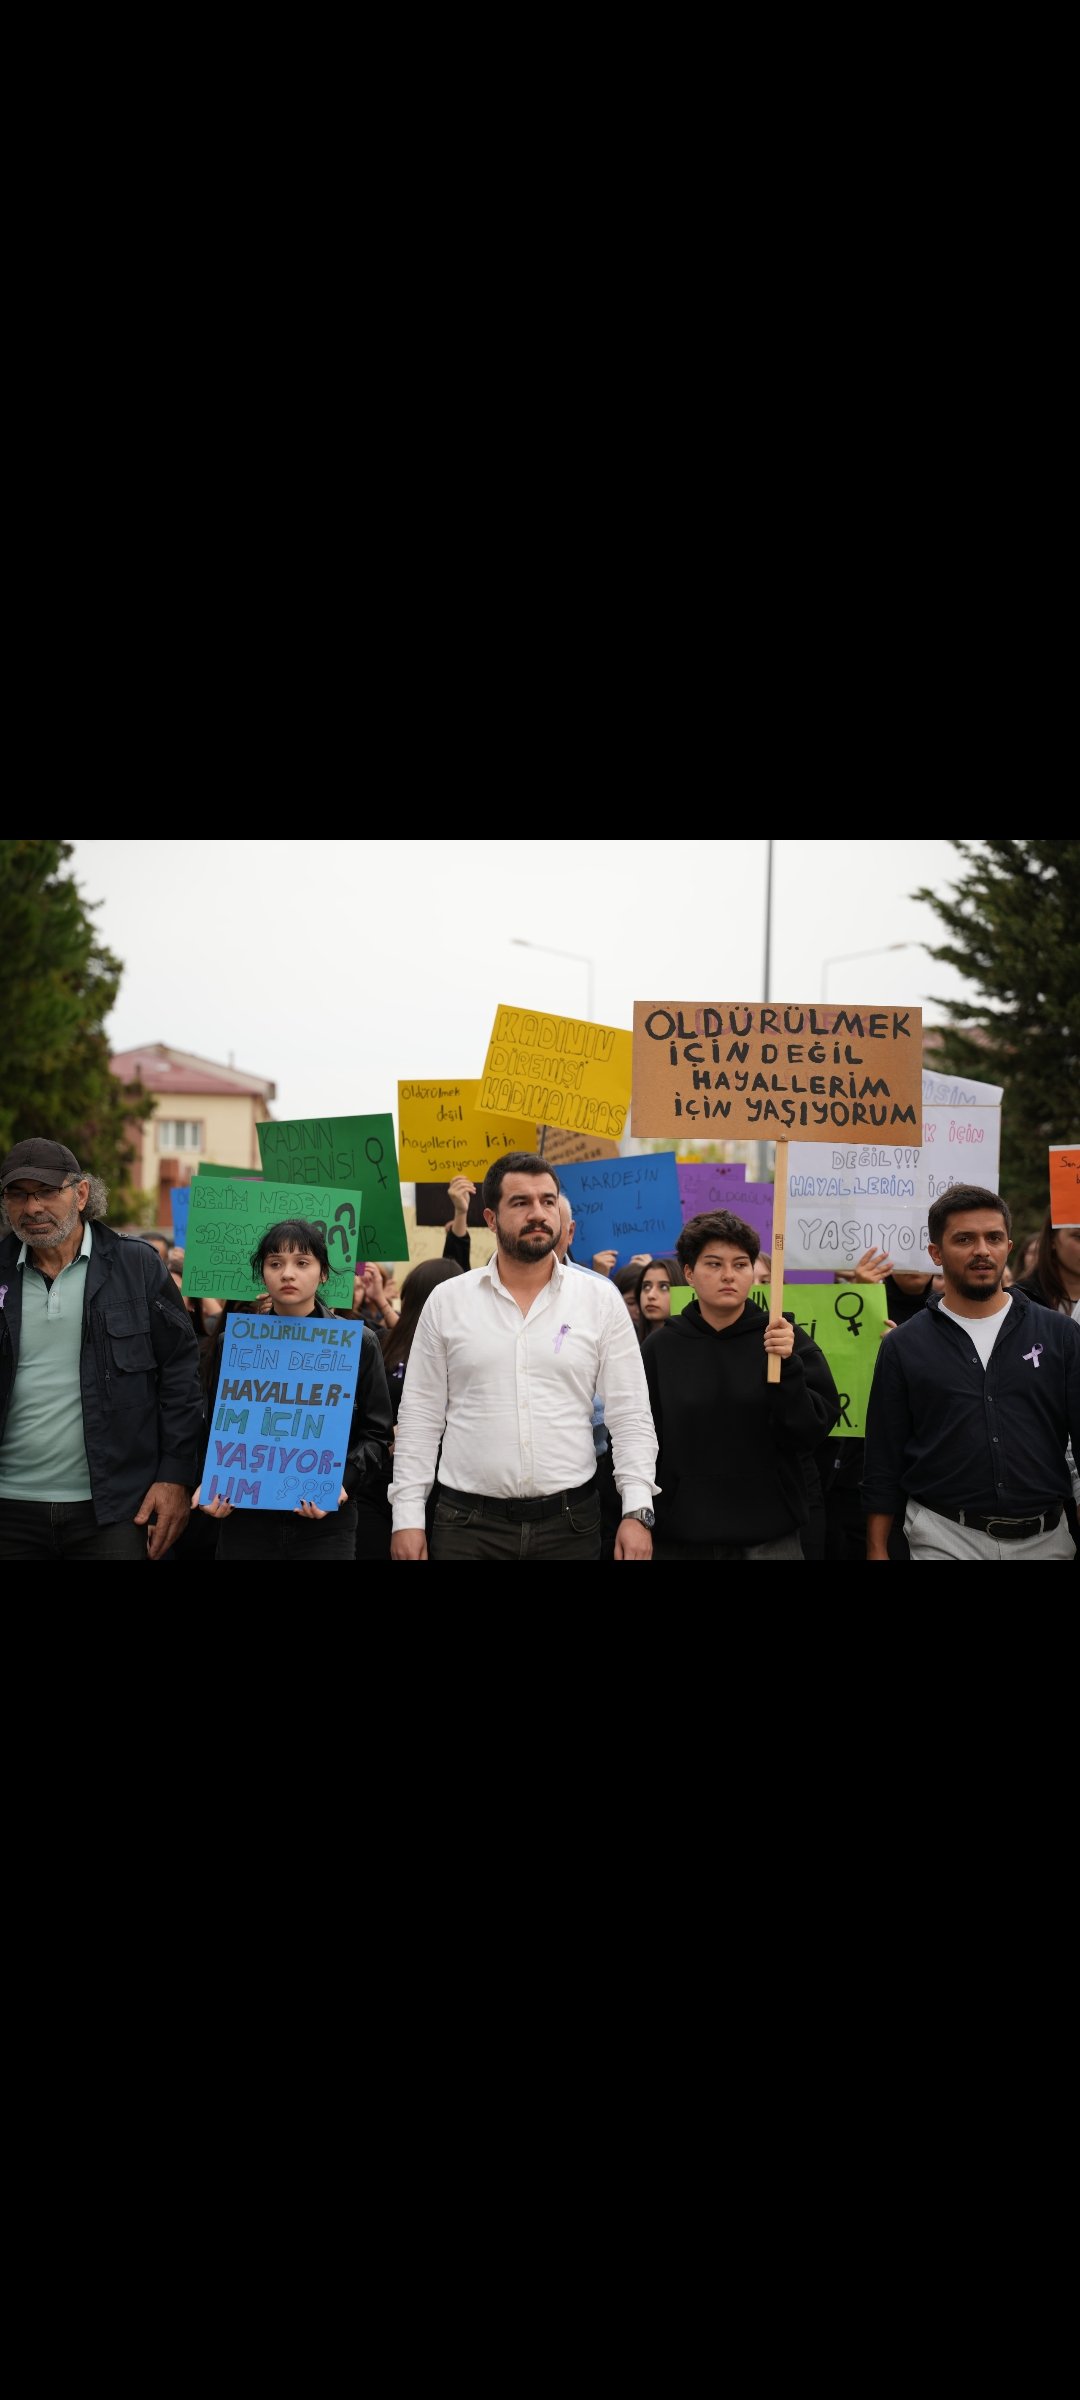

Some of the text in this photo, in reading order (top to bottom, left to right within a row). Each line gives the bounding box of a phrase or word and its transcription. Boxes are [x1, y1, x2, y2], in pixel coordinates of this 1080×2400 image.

[496, 1012, 616, 1062] KADININ
[645, 1005, 911, 1040] ÖLDÜRÜLMEK
[670, 1039, 863, 1067] İÇİN DEĞİL
[693, 1070, 890, 1099] HAYALLERİM
[674, 1092, 917, 1128] İÇİN YAŞIYORUM
[790, 1174, 914, 1197] HAYALLERİM
[231, 1317, 357, 1348] ÖLDÜRÜLMEK
[228, 1343, 353, 1372] İÇİN DEĞİL
[220, 1379, 351, 1406] HAYALLER-
[214, 1403, 325, 1441] İM İÇİN
[214, 1440, 342, 1474] YAŞIYOR-
